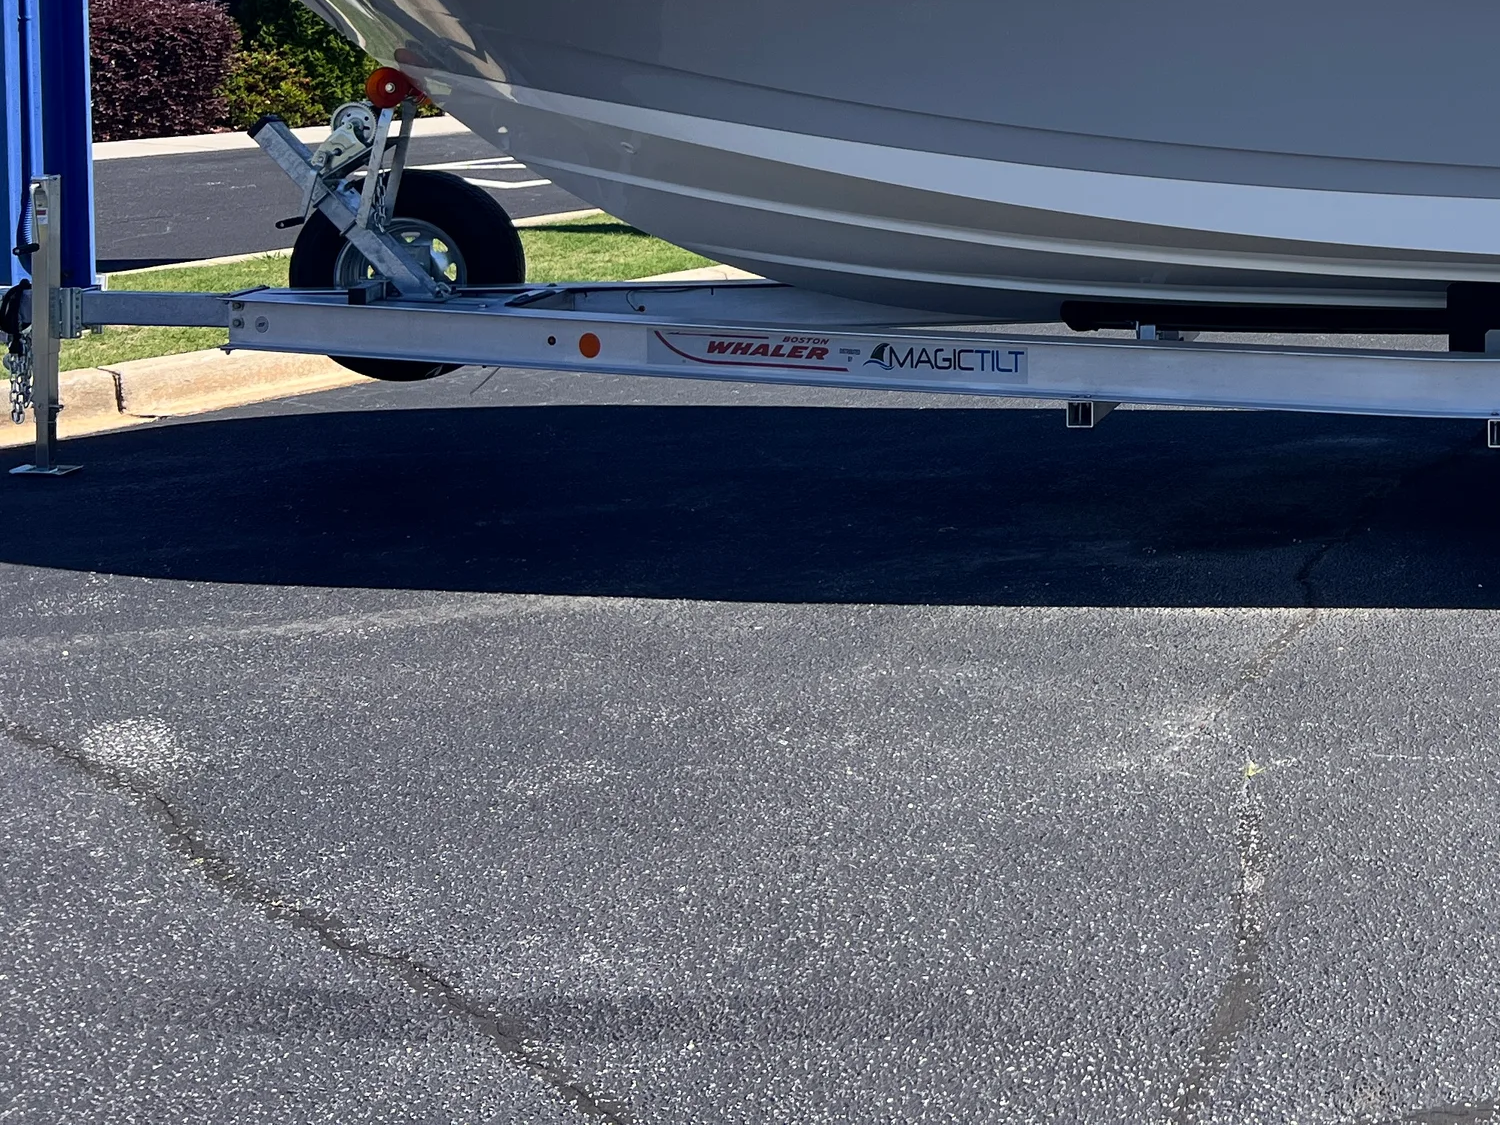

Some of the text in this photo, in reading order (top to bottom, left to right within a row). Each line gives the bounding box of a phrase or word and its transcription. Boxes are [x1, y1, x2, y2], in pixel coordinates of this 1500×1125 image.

[706, 340, 830, 361] WHALER
[782, 336, 830, 345] BOSTON
[888, 347, 1026, 373] MAGICTILT
